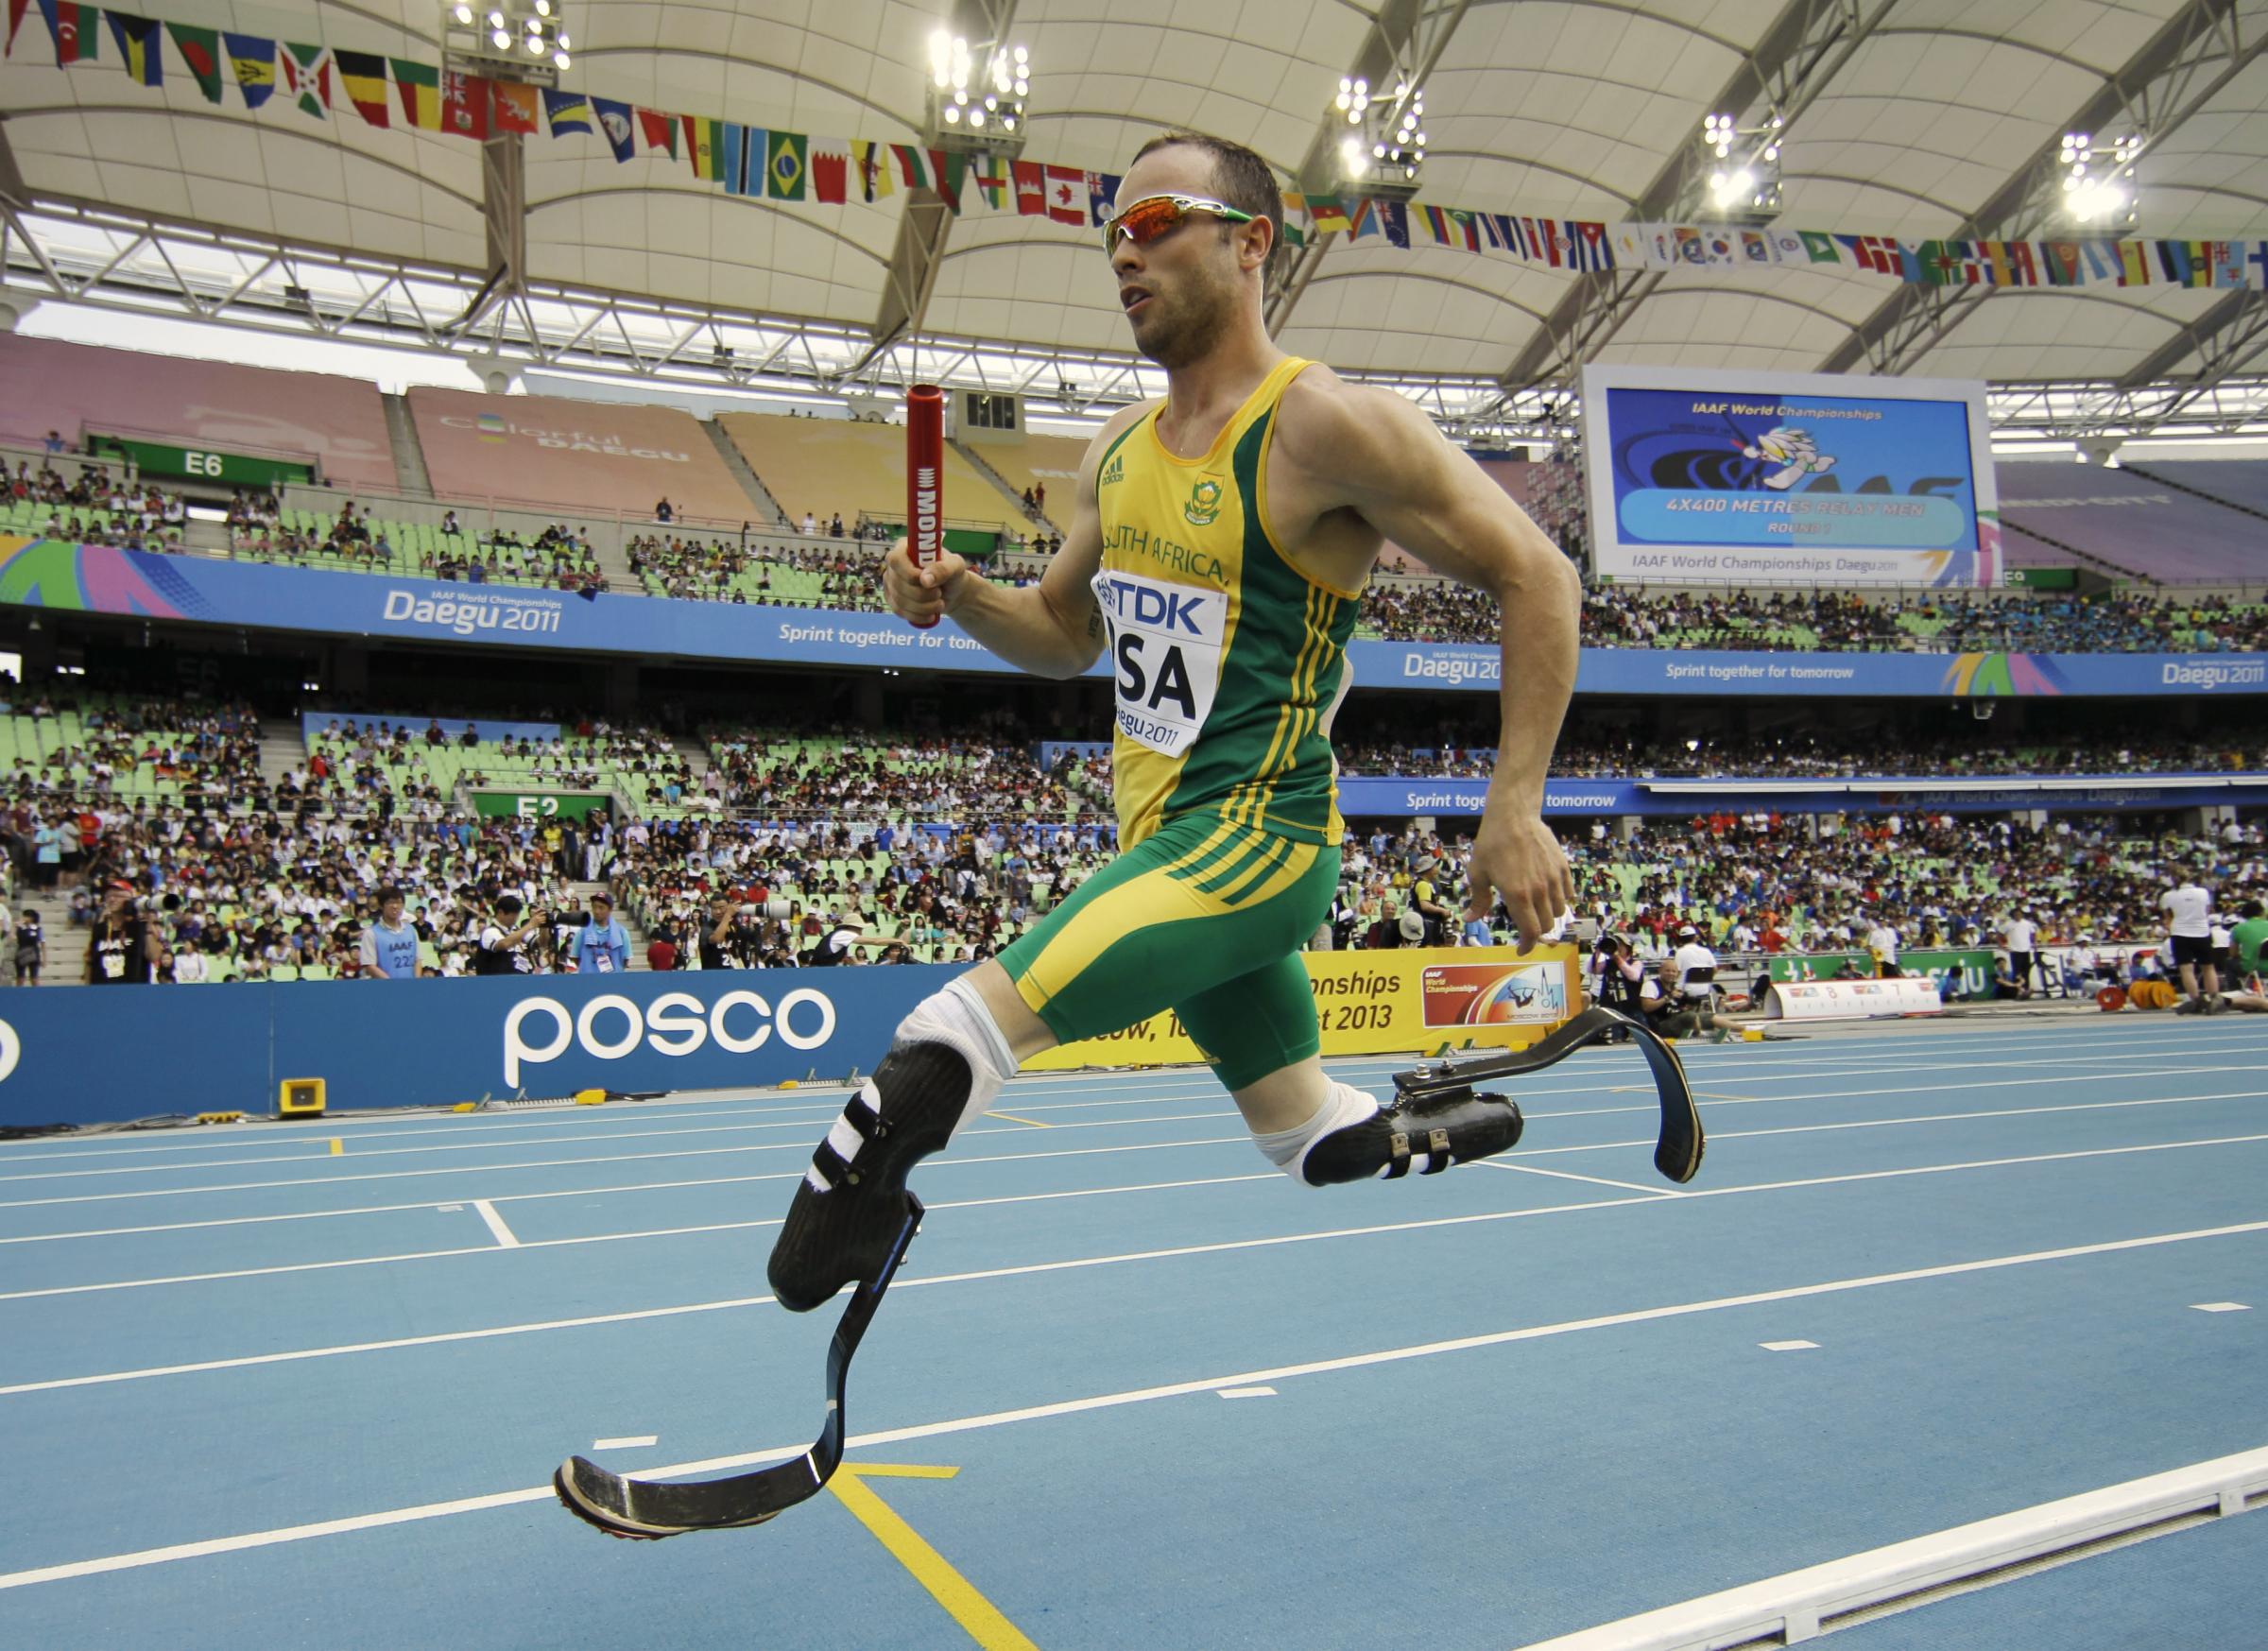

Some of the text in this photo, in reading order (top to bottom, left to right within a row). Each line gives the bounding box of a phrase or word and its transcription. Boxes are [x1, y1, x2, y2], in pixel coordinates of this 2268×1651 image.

[1692, 403, 1882, 421] IAAF World Championships
[185, 451, 223, 476] E6
[1666, 498, 1925, 517] 4X400 METRES RELAY MEN
[1152, 537, 1223, 583] AFRICA
[1632, 556, 1668, 568] IAAF
[1672, 556, 1717, 569] World
[1722, 557, 1831, 573] Championships
[1835, 559, 1876, 575] Daegu
[383, 590, 562, 635] Daegu 2011
[431, 591, 562, 610] IAAF World Championships
[1109, 578, 1206, 636] TDK
[778, 623, 833, 644] Sprint
[838, 627, 916, 649] together
[919, 628, 944, 648] for
[1404, 653, 1477, 684] Daegu
[1666, 663, 1854, 680] Sprint together for tomorrow
[2162, 663, 2264, 689] Daegu 2011
[1145, 723, 1179, 747] 2011
[1406, 793, 1451, 810] Sprint
[1546, 795, 1617, 807] tomorrow
[1425, 985, 1479, 994] Championships
[1335, 1005, 1393, 1030] 2013
[505, 989, 836, 1089] posco
